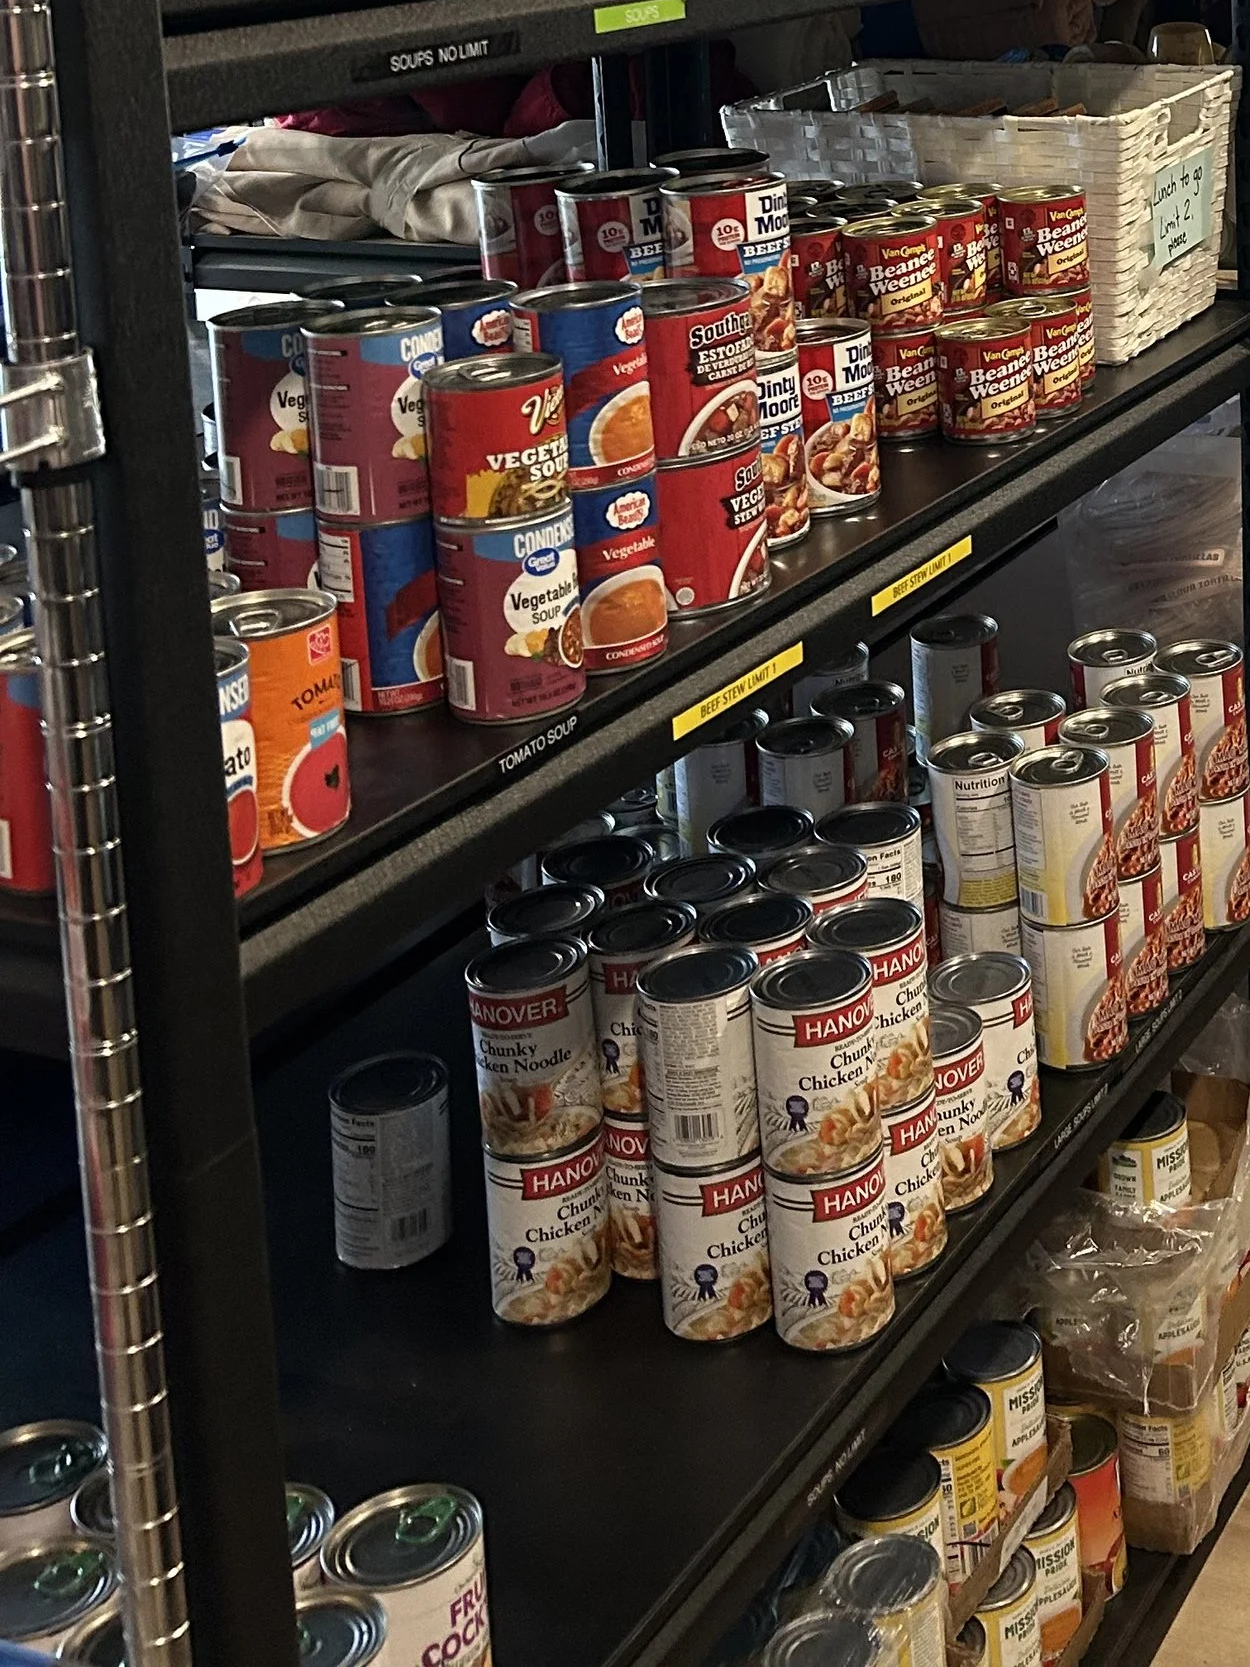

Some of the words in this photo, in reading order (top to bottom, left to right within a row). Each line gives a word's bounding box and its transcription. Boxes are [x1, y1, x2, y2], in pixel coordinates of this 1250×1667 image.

[625, 4, 660, 24] SOUPS
[389, 49, 433, 72] SOUPS
[438, 46, 457, 64] NO
[458, 40, 489, 60] LIMIT
[1152, 177, 1177, 207] Lunch
[1180, 171, 1190, 187] to
[1192, 165, 1203, 197] go
[1159, 210, 1181, 240] Limit
[1056, 249, 1085, 265] Original
[1168, 235, 1188, 258] please
[870, 246, 935, 283] Beanee
[869, 262, 936, 297] Weenee
[890, 288, 926, 306] Original
[969, 349, 1031, 385] Beanee
[969, 368, 1032, 400] Weenee
[990, 391, 1024, 409] Original
[527, 553, 556, 567] Great
[603, 535, 656, 563] Vegetable
[892, 580, 909, 599] BEEF
[909, 568, 928, 589] STEW
[928, 558, 946, 579] LIMIT
[947, 552, 952, 565] 1
[510, 581, 572, 611] Vegetable
[531, 605, 561, 625] SOUP
[700, 697, 721, 719] BEEF
[722, 681, 746, 707] STEW
[747, 667, 771, 691] LIMIT
[771, 662, 777, 675] 1
[498, 735, 546, 774] TOMATO
[547, 715, 578, 745] SOUP
[954, 775, 1005, 792] Nutrition
[880, 848, 901, 860] Facts
[885, 871, 902, 885] 180
[479, 1038, 538, 1058] Chunky
[514, 1048, 572, 1074] Noodle
[798, 1068, 863, 1092] Chicken
[1053, 1121, 1073, 1149] LARGE
[1073, 1102, 1093, 1126] SOUPS
[1115, 1184, 1136, 1194] FAMILY
[525, 1217, 591, 1244] Chicken
[817, 1234, 879, 1266] Chicken
[806, 1468, 834, 1507] SOUPS
[834, 1453, 849, 1475] NO
